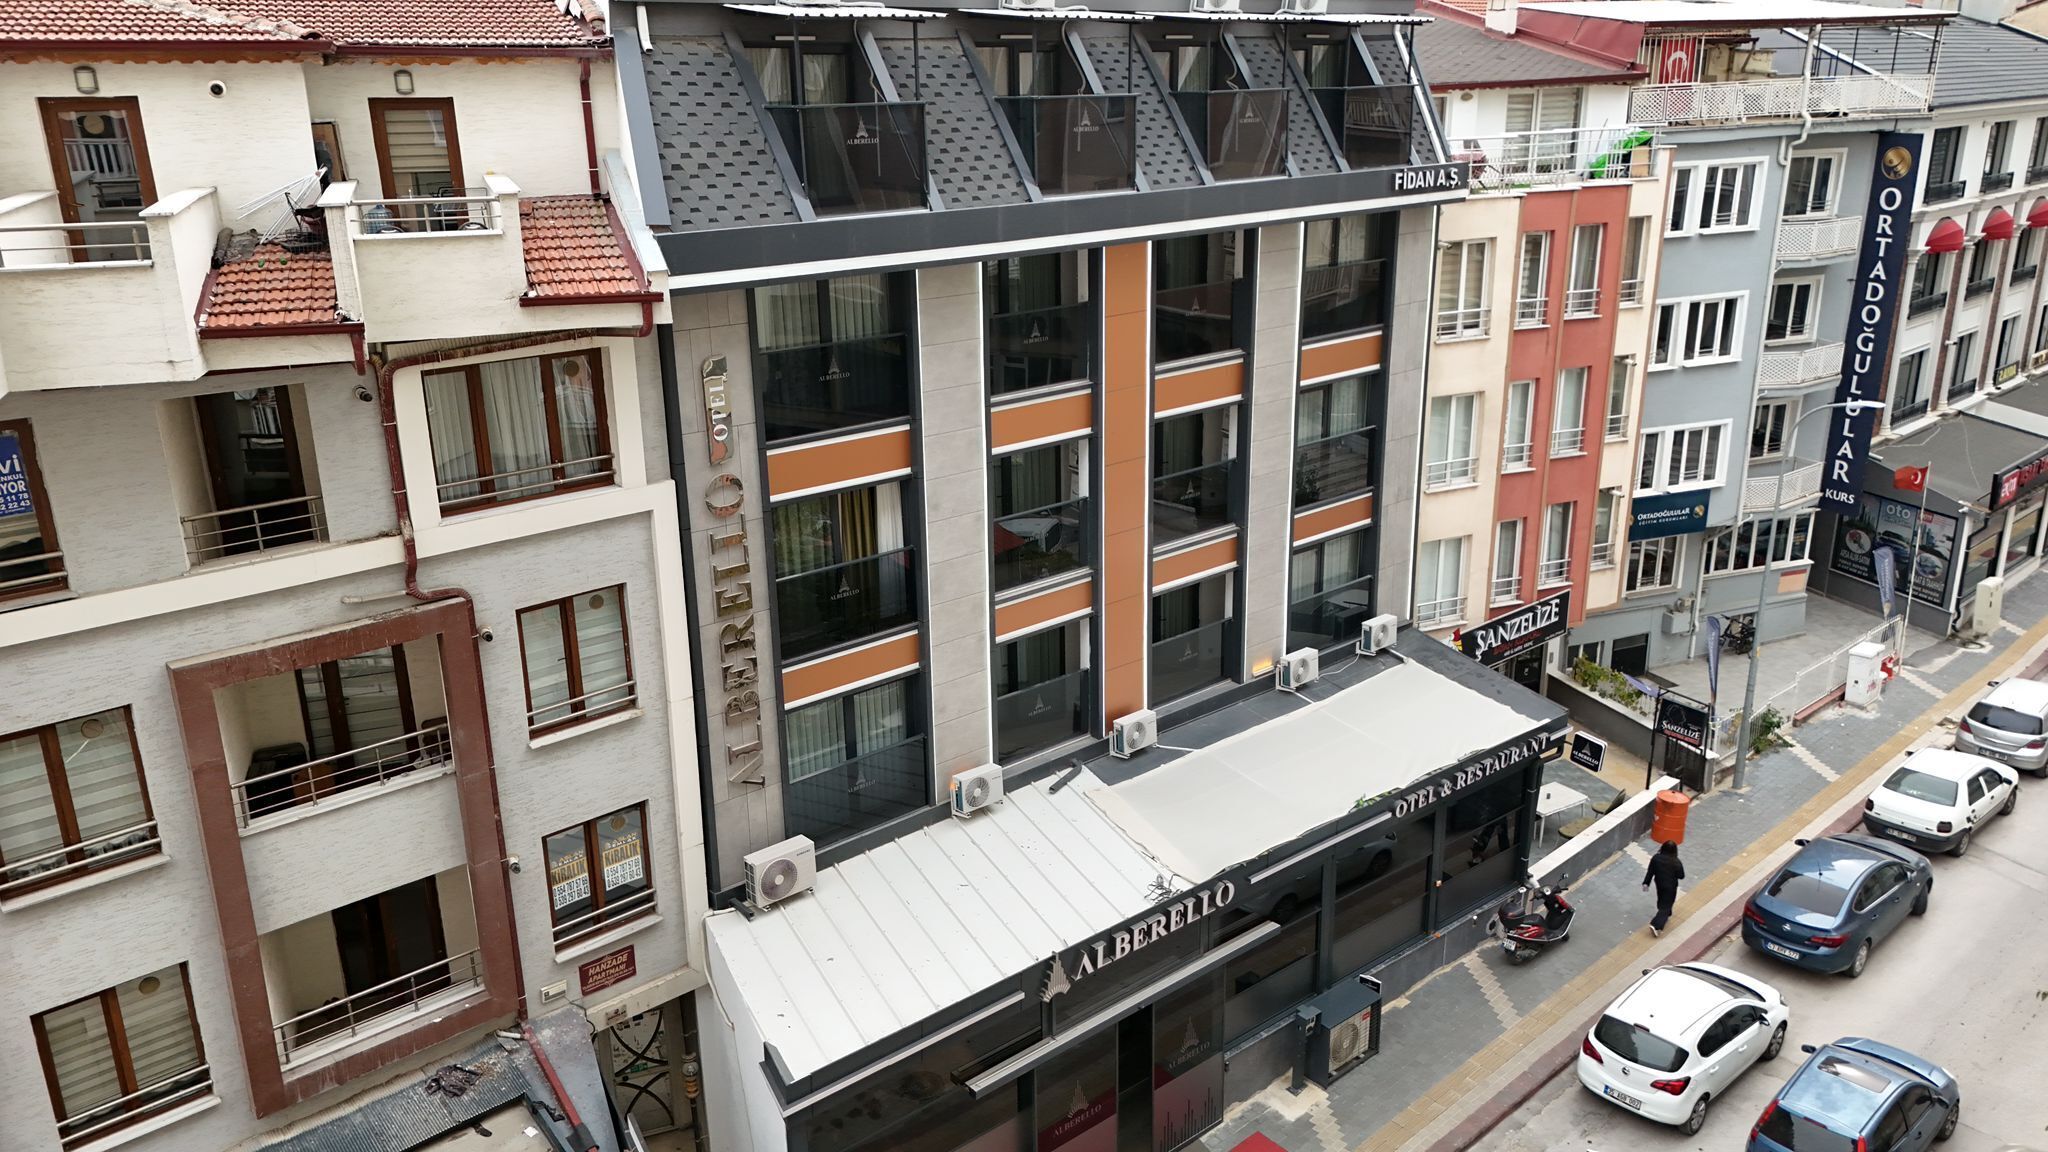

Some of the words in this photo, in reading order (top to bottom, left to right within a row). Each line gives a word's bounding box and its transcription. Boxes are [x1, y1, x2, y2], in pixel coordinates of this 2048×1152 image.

[1394, 168, 1435, 191] FİDAN
[1832, 187, 1902, 484] ORTADOĞULULAR
[709, 382, 729, 441] OTEL
[0, 480, 27, 496] YOR
[1825, 488, 1855, 504] KURS
[1886, 504, 1911, 519] oto
[704, 472, 766, 789] ALBERELLO
[1393, 784, 1438, 819] OTEL
[1440, 778, 1454, 798] &
[1455, 732, 1551, 791] RESTAURANT
[1070, 879, 1235, 981] ALBERELLO
[588, 953, 628, 977] HANZADE
[1053, 1103, 1103, 1138] ALBERELLO
